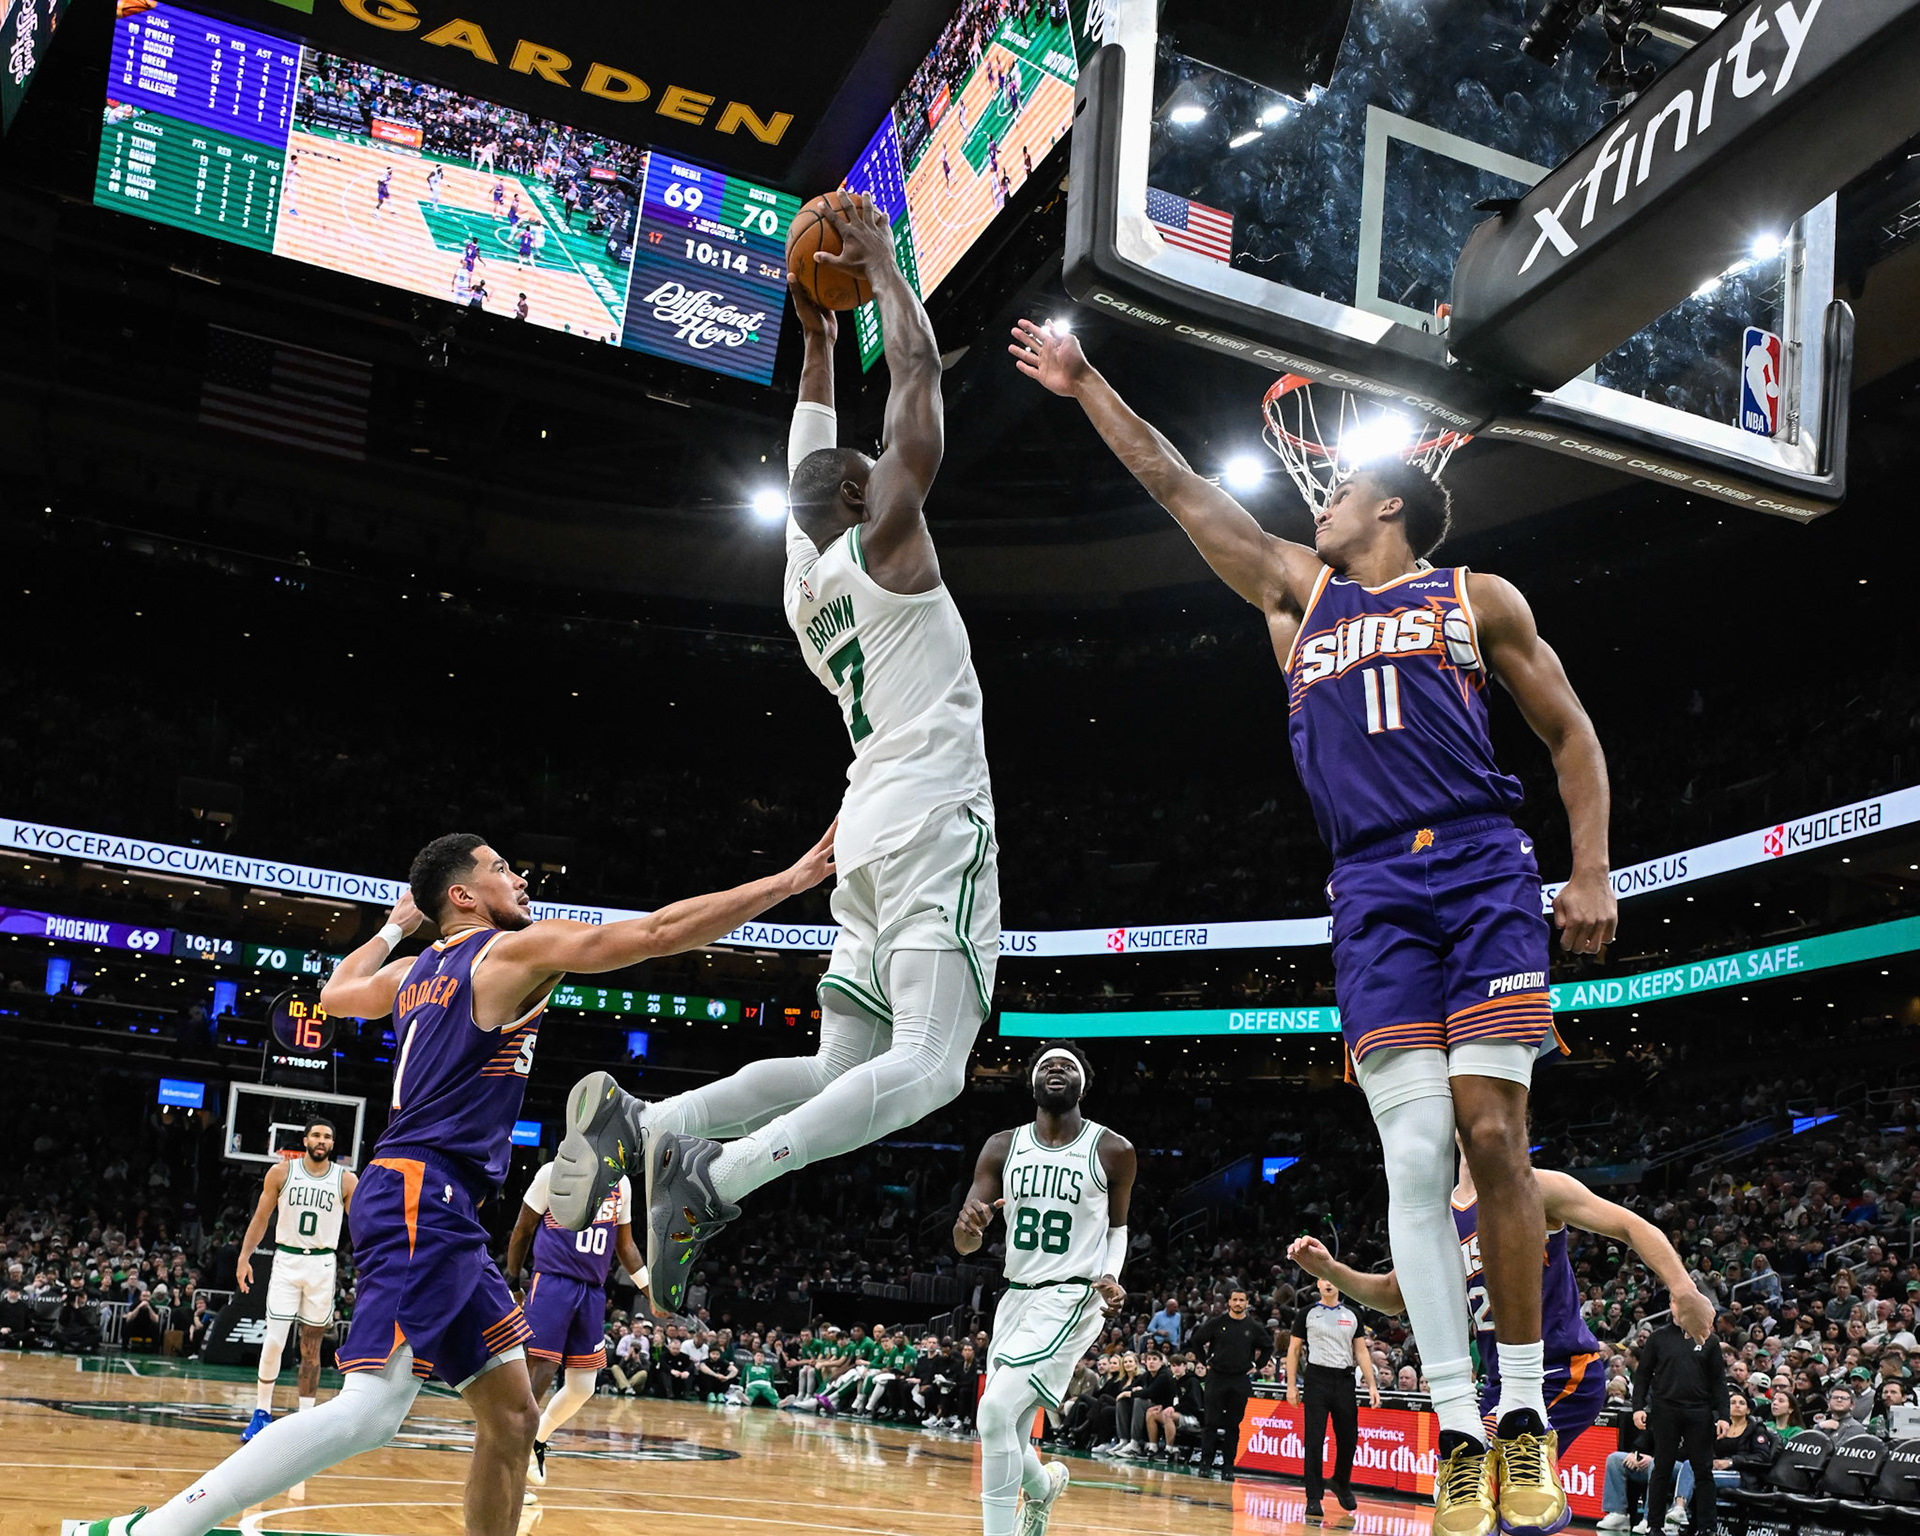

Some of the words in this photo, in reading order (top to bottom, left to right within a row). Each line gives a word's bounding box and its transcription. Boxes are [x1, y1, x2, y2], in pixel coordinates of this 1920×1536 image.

[146, 16, 169, 29] SUNS
[130, 36, 134, 47] 1
[143, 40, 174, 58] BOOKER
[211, 60, 222, 72] 27
[238, 68, 244, 79] 2
[285, 82, 289, 92] 1
[206, 33, 220, 44] PTS
[231, 40, 246, 51] REB
[256, 48, 272, 59] AST
[281, 55, 294, 66] FLS
[141, 53, 166, 68] GREEN
[211, 73, 219, 84] 15
[283, 94, 287, 104] 1
[215, 49, 221, 59] 6
[239, 56, 245, 66] 2
[263, 63, 270, 74] 2
[286, 70, 290, 80] 1
[340, 0, 794, 146] GARDEN
[123, 73, 132, 85] 12
[138, 77, 177, 98] GILLESPIE
[208, 98, 215, 108] 3
[232, 105, 239, 115] 3
[258, 112, 262, 122] 1
[280, 118, 284, 128] 1
[126, 60, 133, 71] 11
[210, 86, 217, 96] 2
[235, 93, 239, 103] 1
[258, 100, 264, 110] 6
[280, 106, 286, 116] 2
[133, 121, 163, 136] CELTICS
[1518, 0, 1822, 276] xfinity
[116, 144, 122, 154] 7
[223, 174, 229, 185] 2
[247, 181, 253, 191] 5
[192, 139, 206, 150] PTS
[242, 153, 258, 164] AST
[267, 160, 280, 170] FLS
[128, 160, 152, 176] WHITE
[222, 187, 228, 197] 3
[246, 193, 252, 204] 2
[225, 162, 231, 173] 2
[249, 169, 255, 179] 3
[670, 164, 701, 182] PHOENIX
[663, 183, 704, 212] 69
[195, 204, 201, 215] 5
[219, 211, 225, 222] 2
[265, 223, 269, 233] 1
[244, 205, 250, 216] 2
[266, 212, 272, 221] 2
[740, 204, 778, 235] 70
[648, 231, 663, 244] 17
[685, 239, 748, 275] 10:14
[758, 264, 780, 279] 3rd
[642, 281, 766, 332] Different
[1093, 293, 1131, 312] C4
[1126, 307, 1171, 326] ENERGY
[652, 307, 748, 350] Here
[1175, 324, 1210, 339] C4
[1207, 335, 1249, 351] ENERGY
[1253, 349, 1288, 365] C4
[1284, 358, 1326, 375] ENERGY
[1329, 373, 1362, 386] C4
[1359, 383, 1400, 397] ENERGY
[1402, 395, 1438, 412] C4
[1431, 407, 1472, 426] ENERGY
[1745, 410, 1765, 432] NBA
[1490, 425, 1524, 436] C4
[1520, 429, 1557, 441] ENERGY
[1560, 440, 1593, 452] C4
[1588, 447, 1626, 461] ENERGY
[1628, 460, 1660, 472] C4
[1655, 467, 1692, 482] ENERGY
[1692, 479, 1724, 492] C4
[1718, 486, 1757, 502] ENERGY
[1755, 499, 1786, 511] C4
[1781, 505, 1818, 518] ENERGY
[1409, 580, 1449, 590] PayPal
[806, 594, 855, 655] BROWN
[827, 636, 874, 744] 7
[1362, 664, 1405, 734] 11
[1610, 856, 1688, 892] IONS.US
[529, 906, 602, 926] YOCERA
[45, 916, 108, 944] PHOENIX
[126, 929, 160, 951] 69
[185, 934, 233, 954] 10:14
[256, 948, 287, 970] 70
[201, 951, 215, 961] 3rd
[1488, 971, 1545, 998] PHOENIX
[1571, 981, 1623, 1007] AND
[1629, 971, 1684, 1000] KEEPS
[1690, 958, 1740, 989] DATA
[1746, 945, 1804, 978] SAFE.
[289, 1000, 327, 1021] 10:14
[399, 974, 458, 1018] BOOKER
[555, 994, 583, 1006] 13/25
[598, 998, 606, 1008] 5
[624, 1000, 631, 1010] 3
[647, 1003, 660, 1013] 20
[674, 1005, 686, 1015] 19
[745, 1007, 758, 1018] 17
[1229, 1010, 1319, 1030] DEFENSE
[295, 1019, 322, 1048] 16
[287, 1057, 328, 1070] TISSOT
[392, 1018, 417, 1109] 1
[289, 1187, 334, 1212] CELTICS
[1011, 1165, 1083, 1205] CELTICS
[299, 1211, 318, 1236] 0
[1014, 1207, 1072, 1255] 88
[576, 1226, 608, 1255] 00
[1251, 1415, 1293, 1430] experience
[1357, 1426, 1404, 1442] experience
[1248, 1430, 1278, 1455] abu
[1784, 1441, 1822, 1456] PIMCO
[1838, 1446, 1876, 1460] PIMCO
[1891, 1451, 1920, 1463] PIMC
[1353, 1441, 1387, 1470] abu
[1389, 1445, 1439, 1477] dhab
